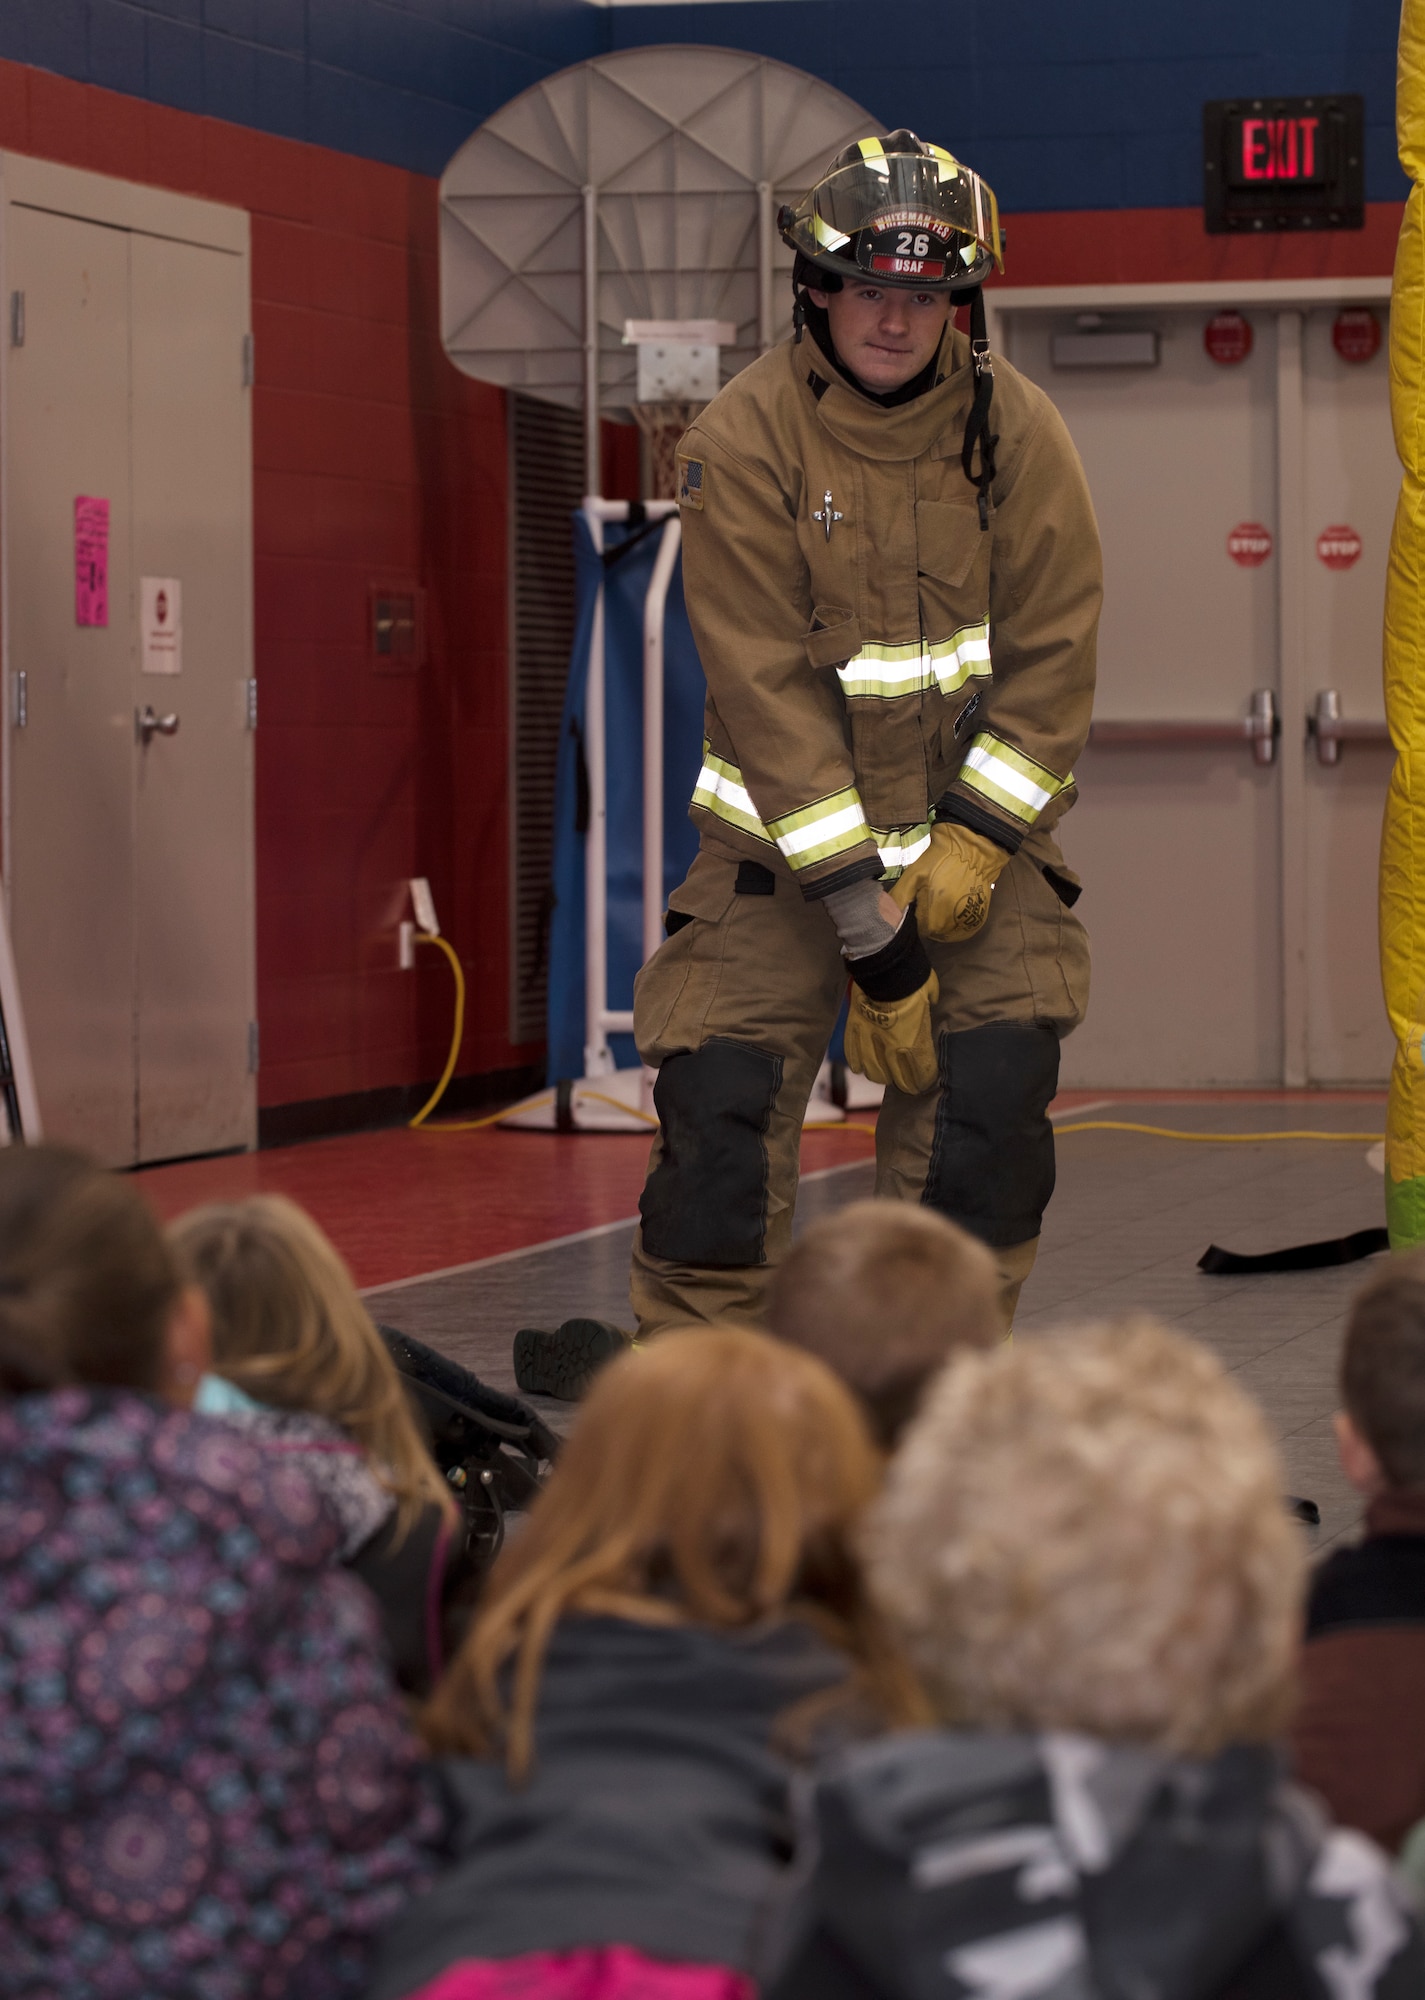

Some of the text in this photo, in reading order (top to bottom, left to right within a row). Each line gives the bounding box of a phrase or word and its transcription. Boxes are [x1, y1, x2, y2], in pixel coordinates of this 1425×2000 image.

[1243, 118, 1318, 178] EXIT
[875, 211, 950, 238] WHITEMAN FES
[896, 231, 930, 257] 26
[895, 259, 924, 274] USAF
[1230, 538, 1270, 554] STOP
[1319, 540, 1359, 556] STOP
